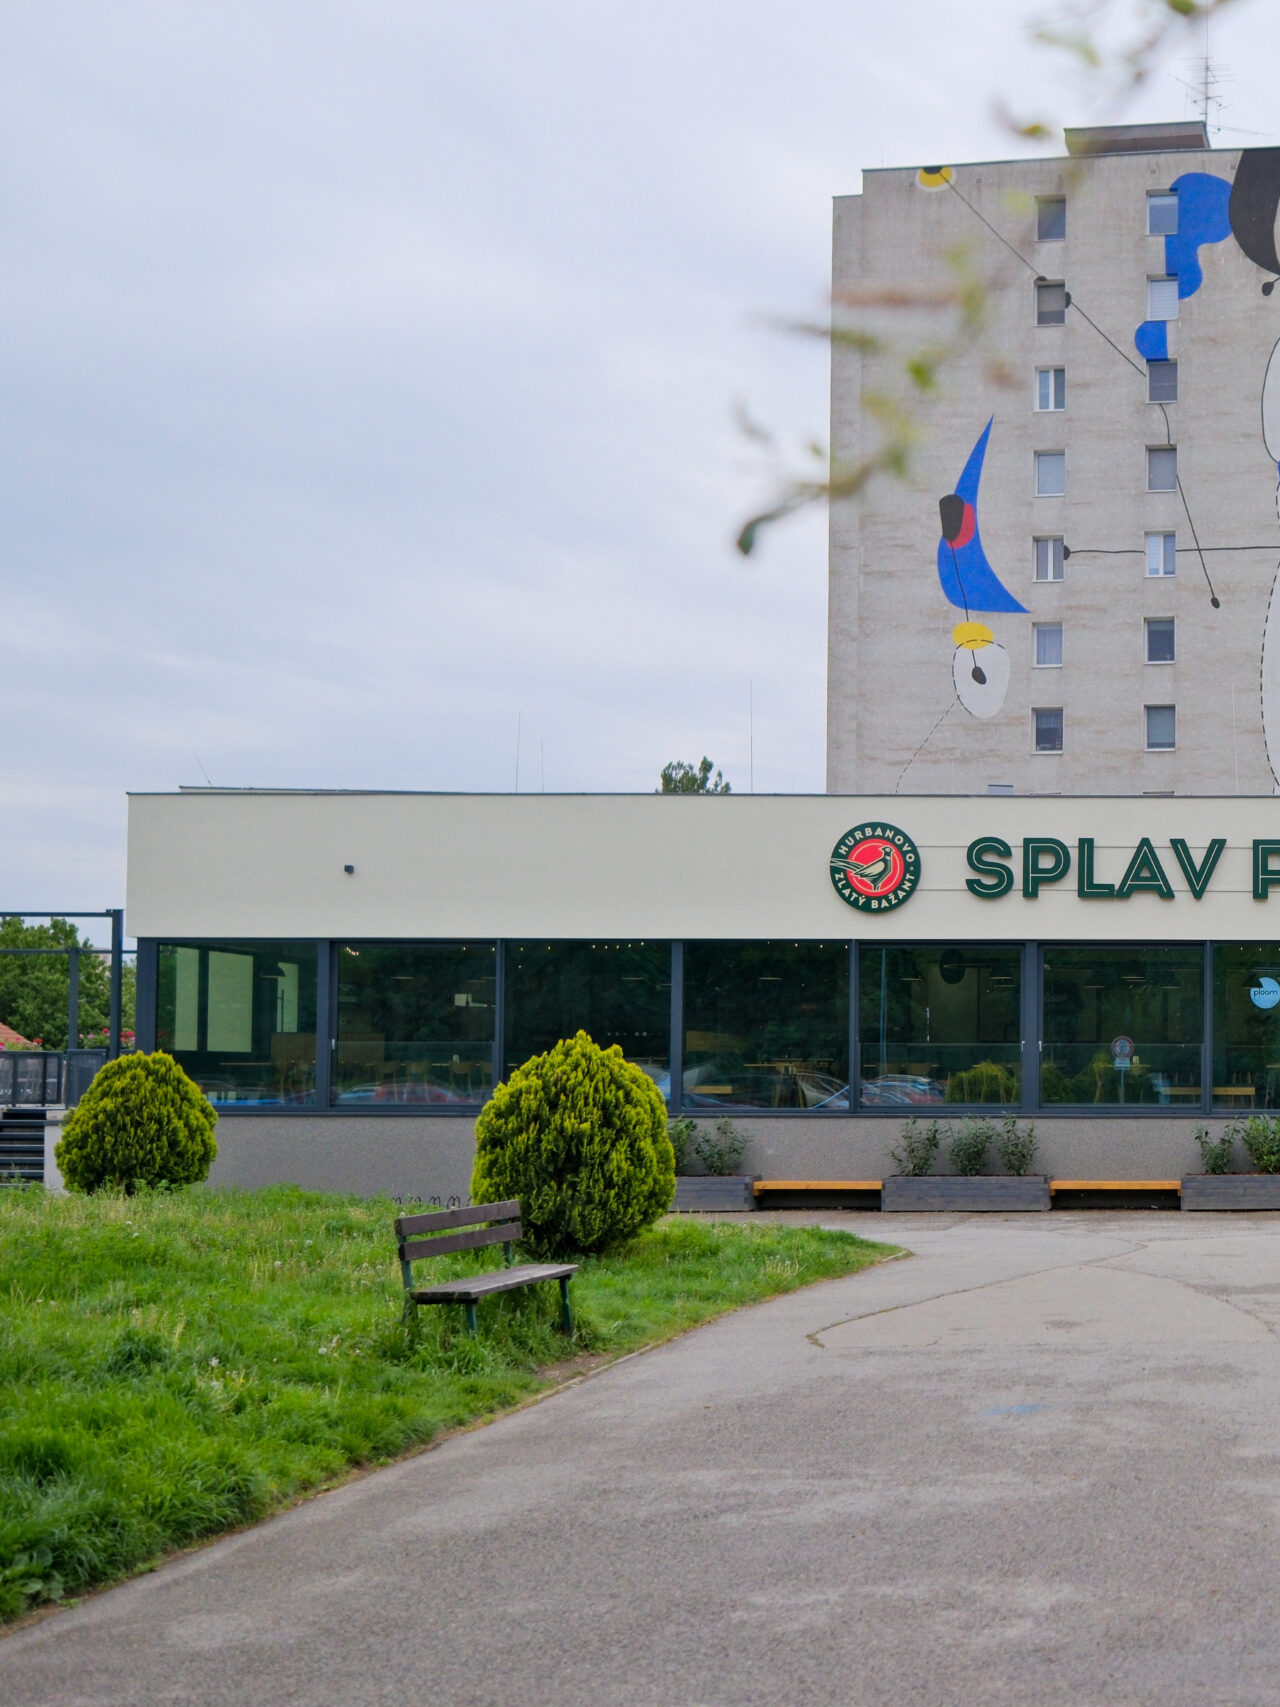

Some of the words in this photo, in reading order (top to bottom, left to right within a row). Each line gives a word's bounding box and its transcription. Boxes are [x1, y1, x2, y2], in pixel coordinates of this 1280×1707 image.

[838, 827, 915, 862] HURBANOVO
[965, 836, 1227, 899] SPLAV
[835, 872, 866, 906] ZLATÝ
[871, 873, 915, 909] BAŽANT
[1253, 988, 1278, 999] ploom
